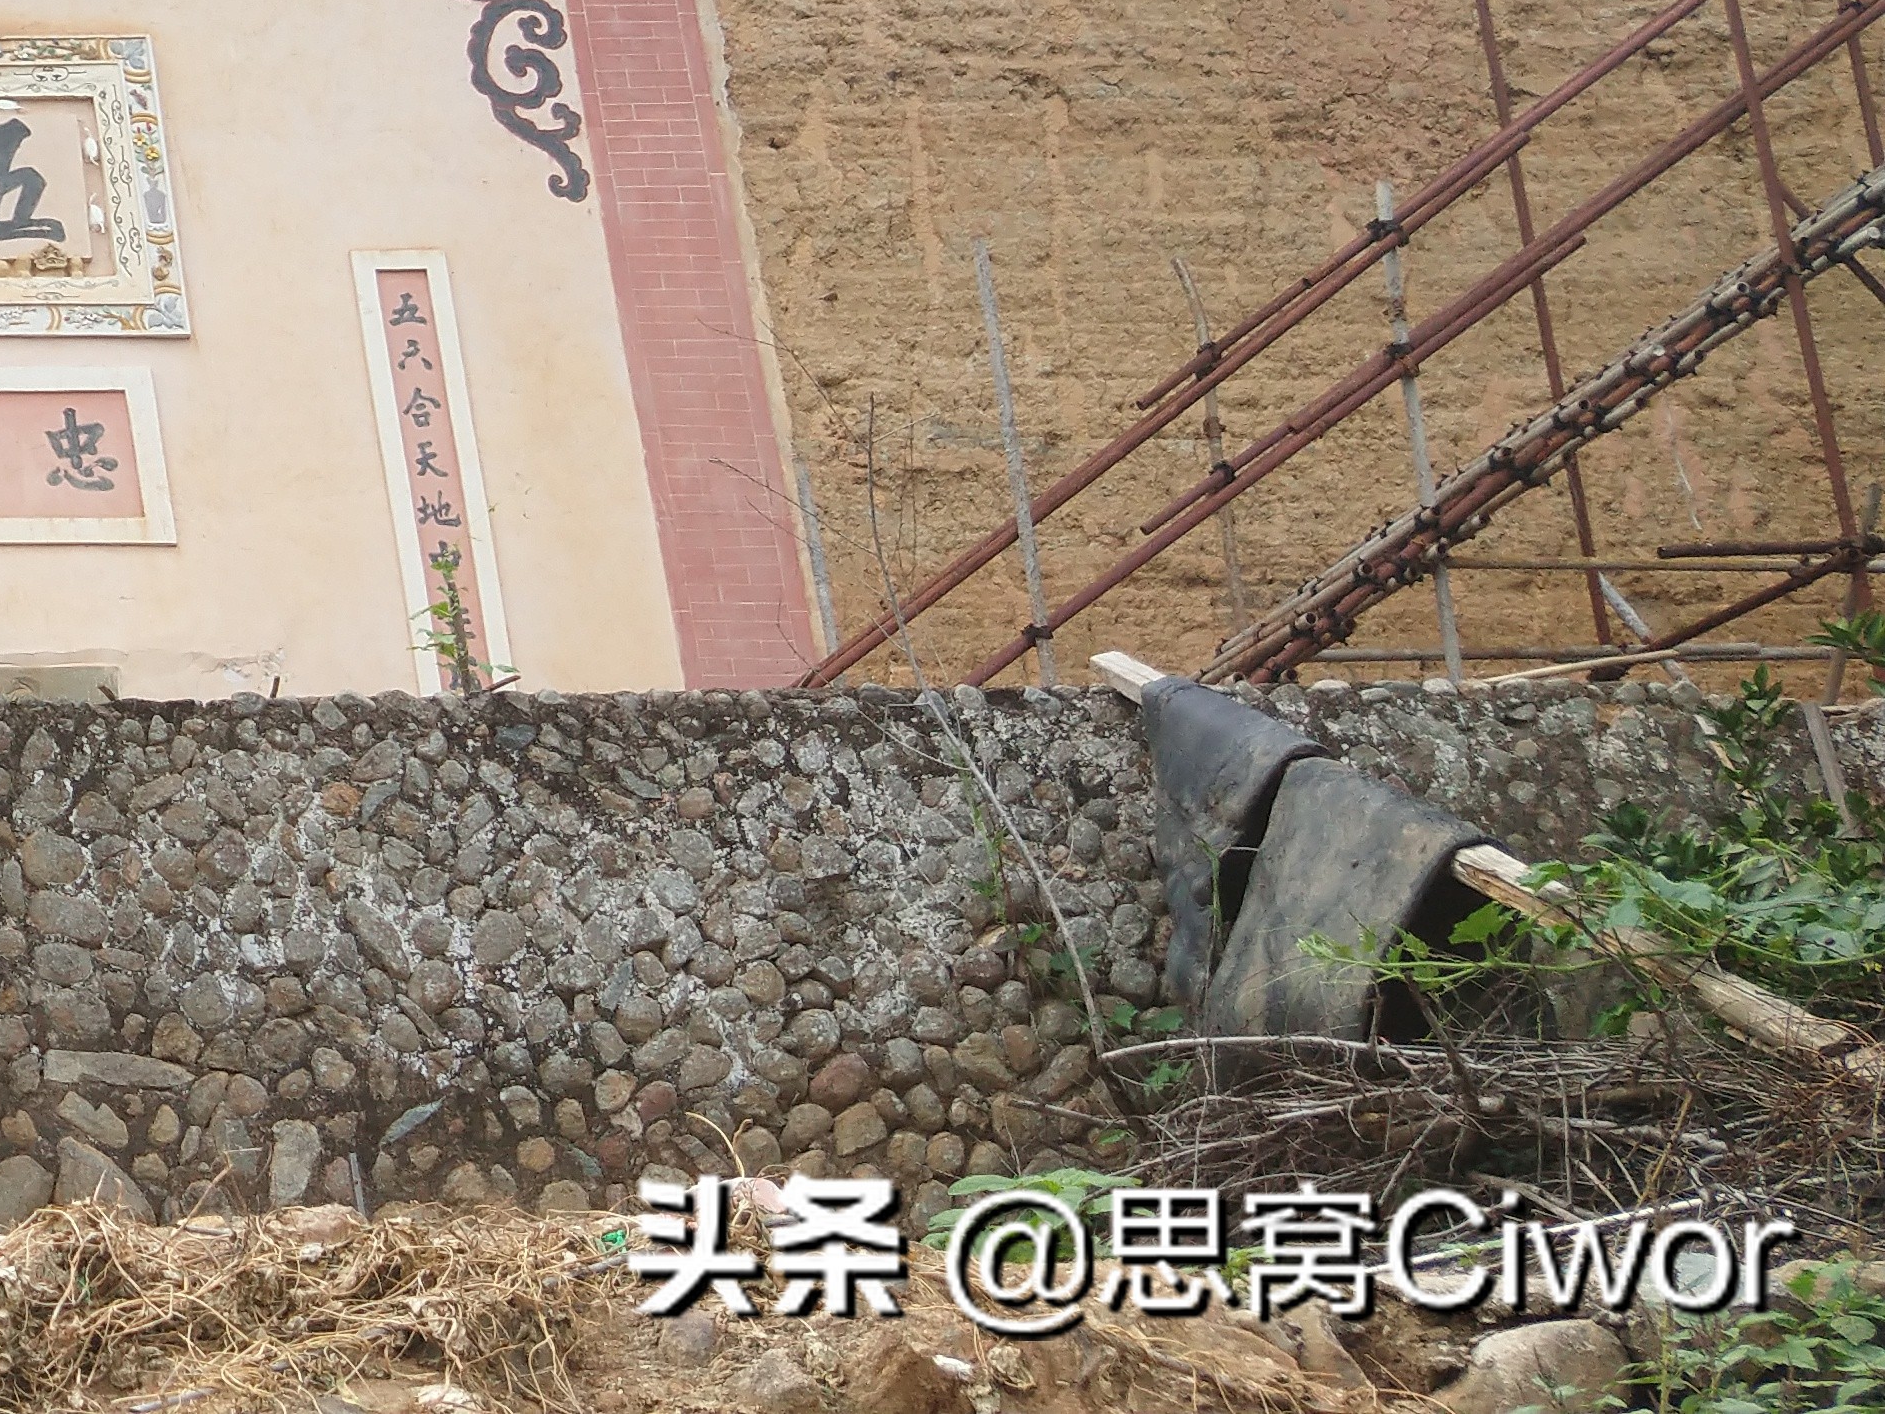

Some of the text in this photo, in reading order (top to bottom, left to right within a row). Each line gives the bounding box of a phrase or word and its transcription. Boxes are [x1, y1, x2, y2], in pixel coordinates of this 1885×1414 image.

[389, 292, 482, 692] 五六合天地中
